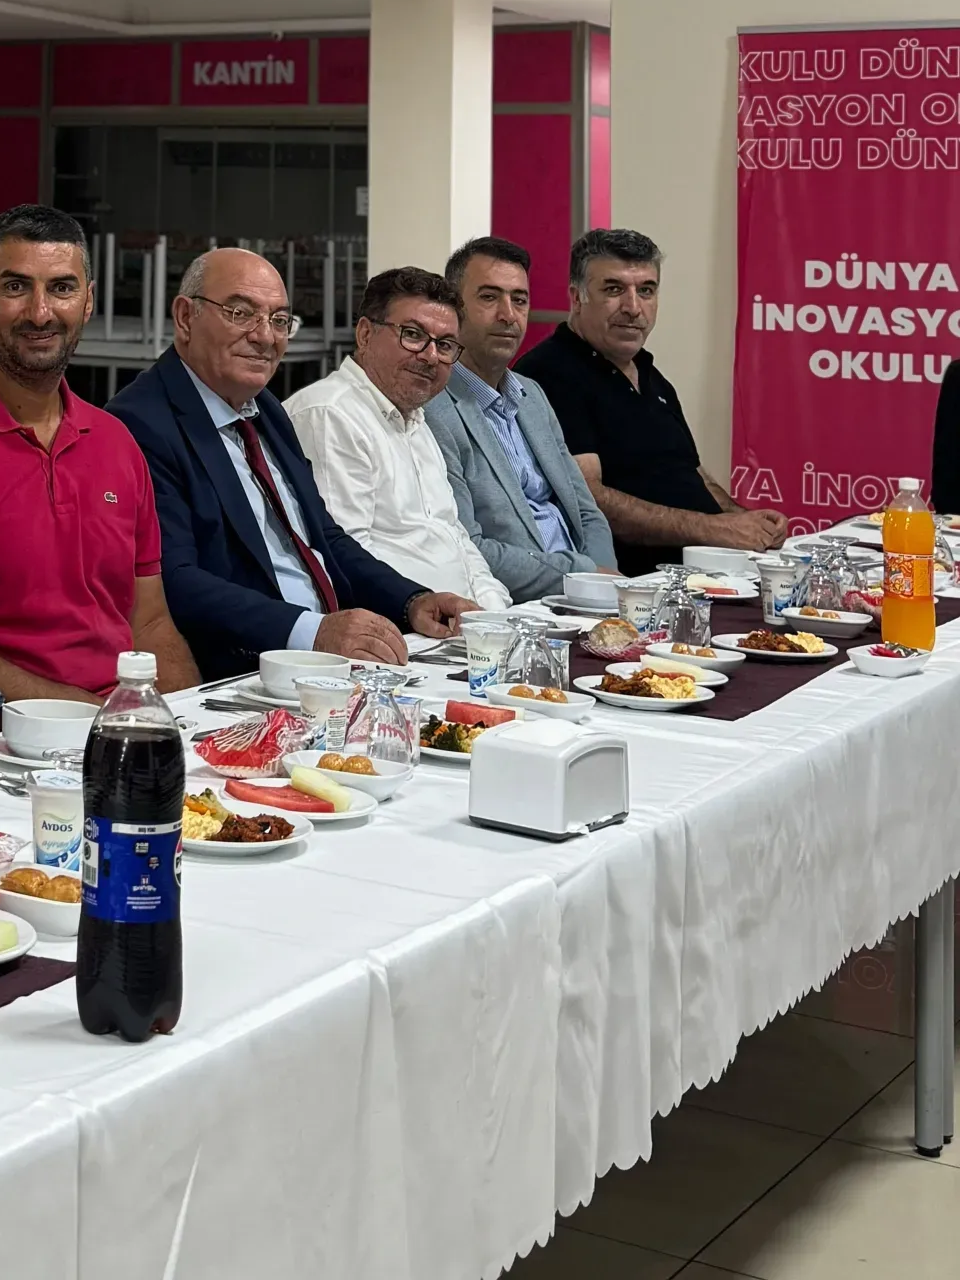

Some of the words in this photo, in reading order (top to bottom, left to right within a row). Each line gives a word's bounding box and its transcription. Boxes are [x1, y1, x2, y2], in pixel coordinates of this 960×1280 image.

[193, 53, 295, 87] KANTİN
[739, 93, 905, 127] ASYON
[921, 92, 960, 125] O
[857, 128, 960, 170] DÜN
[804, 252, 959, 293] DÜNYA
[809, 349, 952, 384] OKULU
[42, 820, 73, 832] AYDOS
